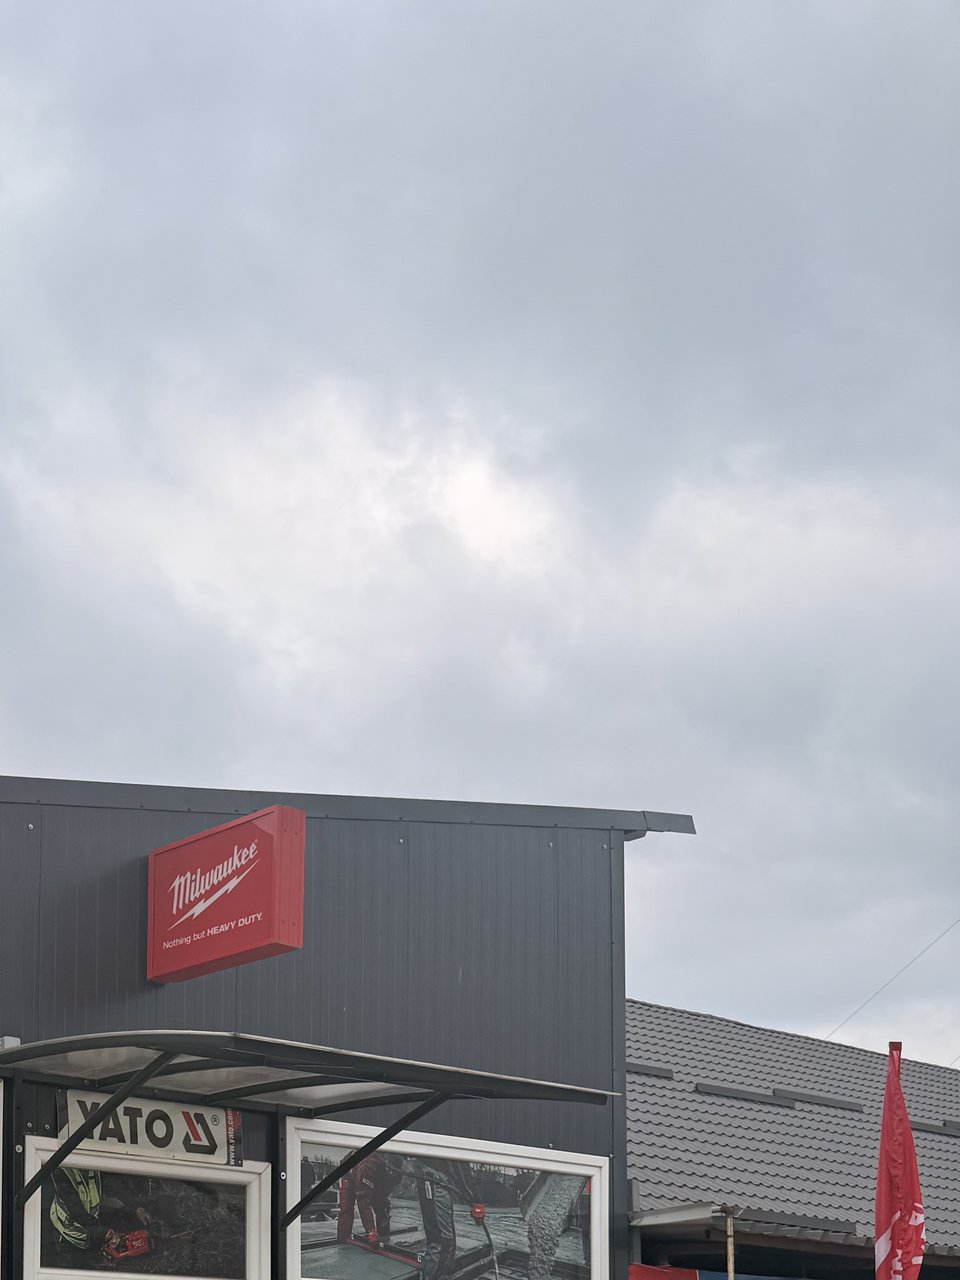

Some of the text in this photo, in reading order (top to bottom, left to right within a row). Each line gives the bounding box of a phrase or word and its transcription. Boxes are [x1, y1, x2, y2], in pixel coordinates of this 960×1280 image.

[168, 843, 258, 915] Milwaukee
[162, 936, 191, 949] Nothing
[193, 931, 205, 941] but
[207, 921, 236, 936] HEAVY
[76, 1099, 174, 1149] YATO
